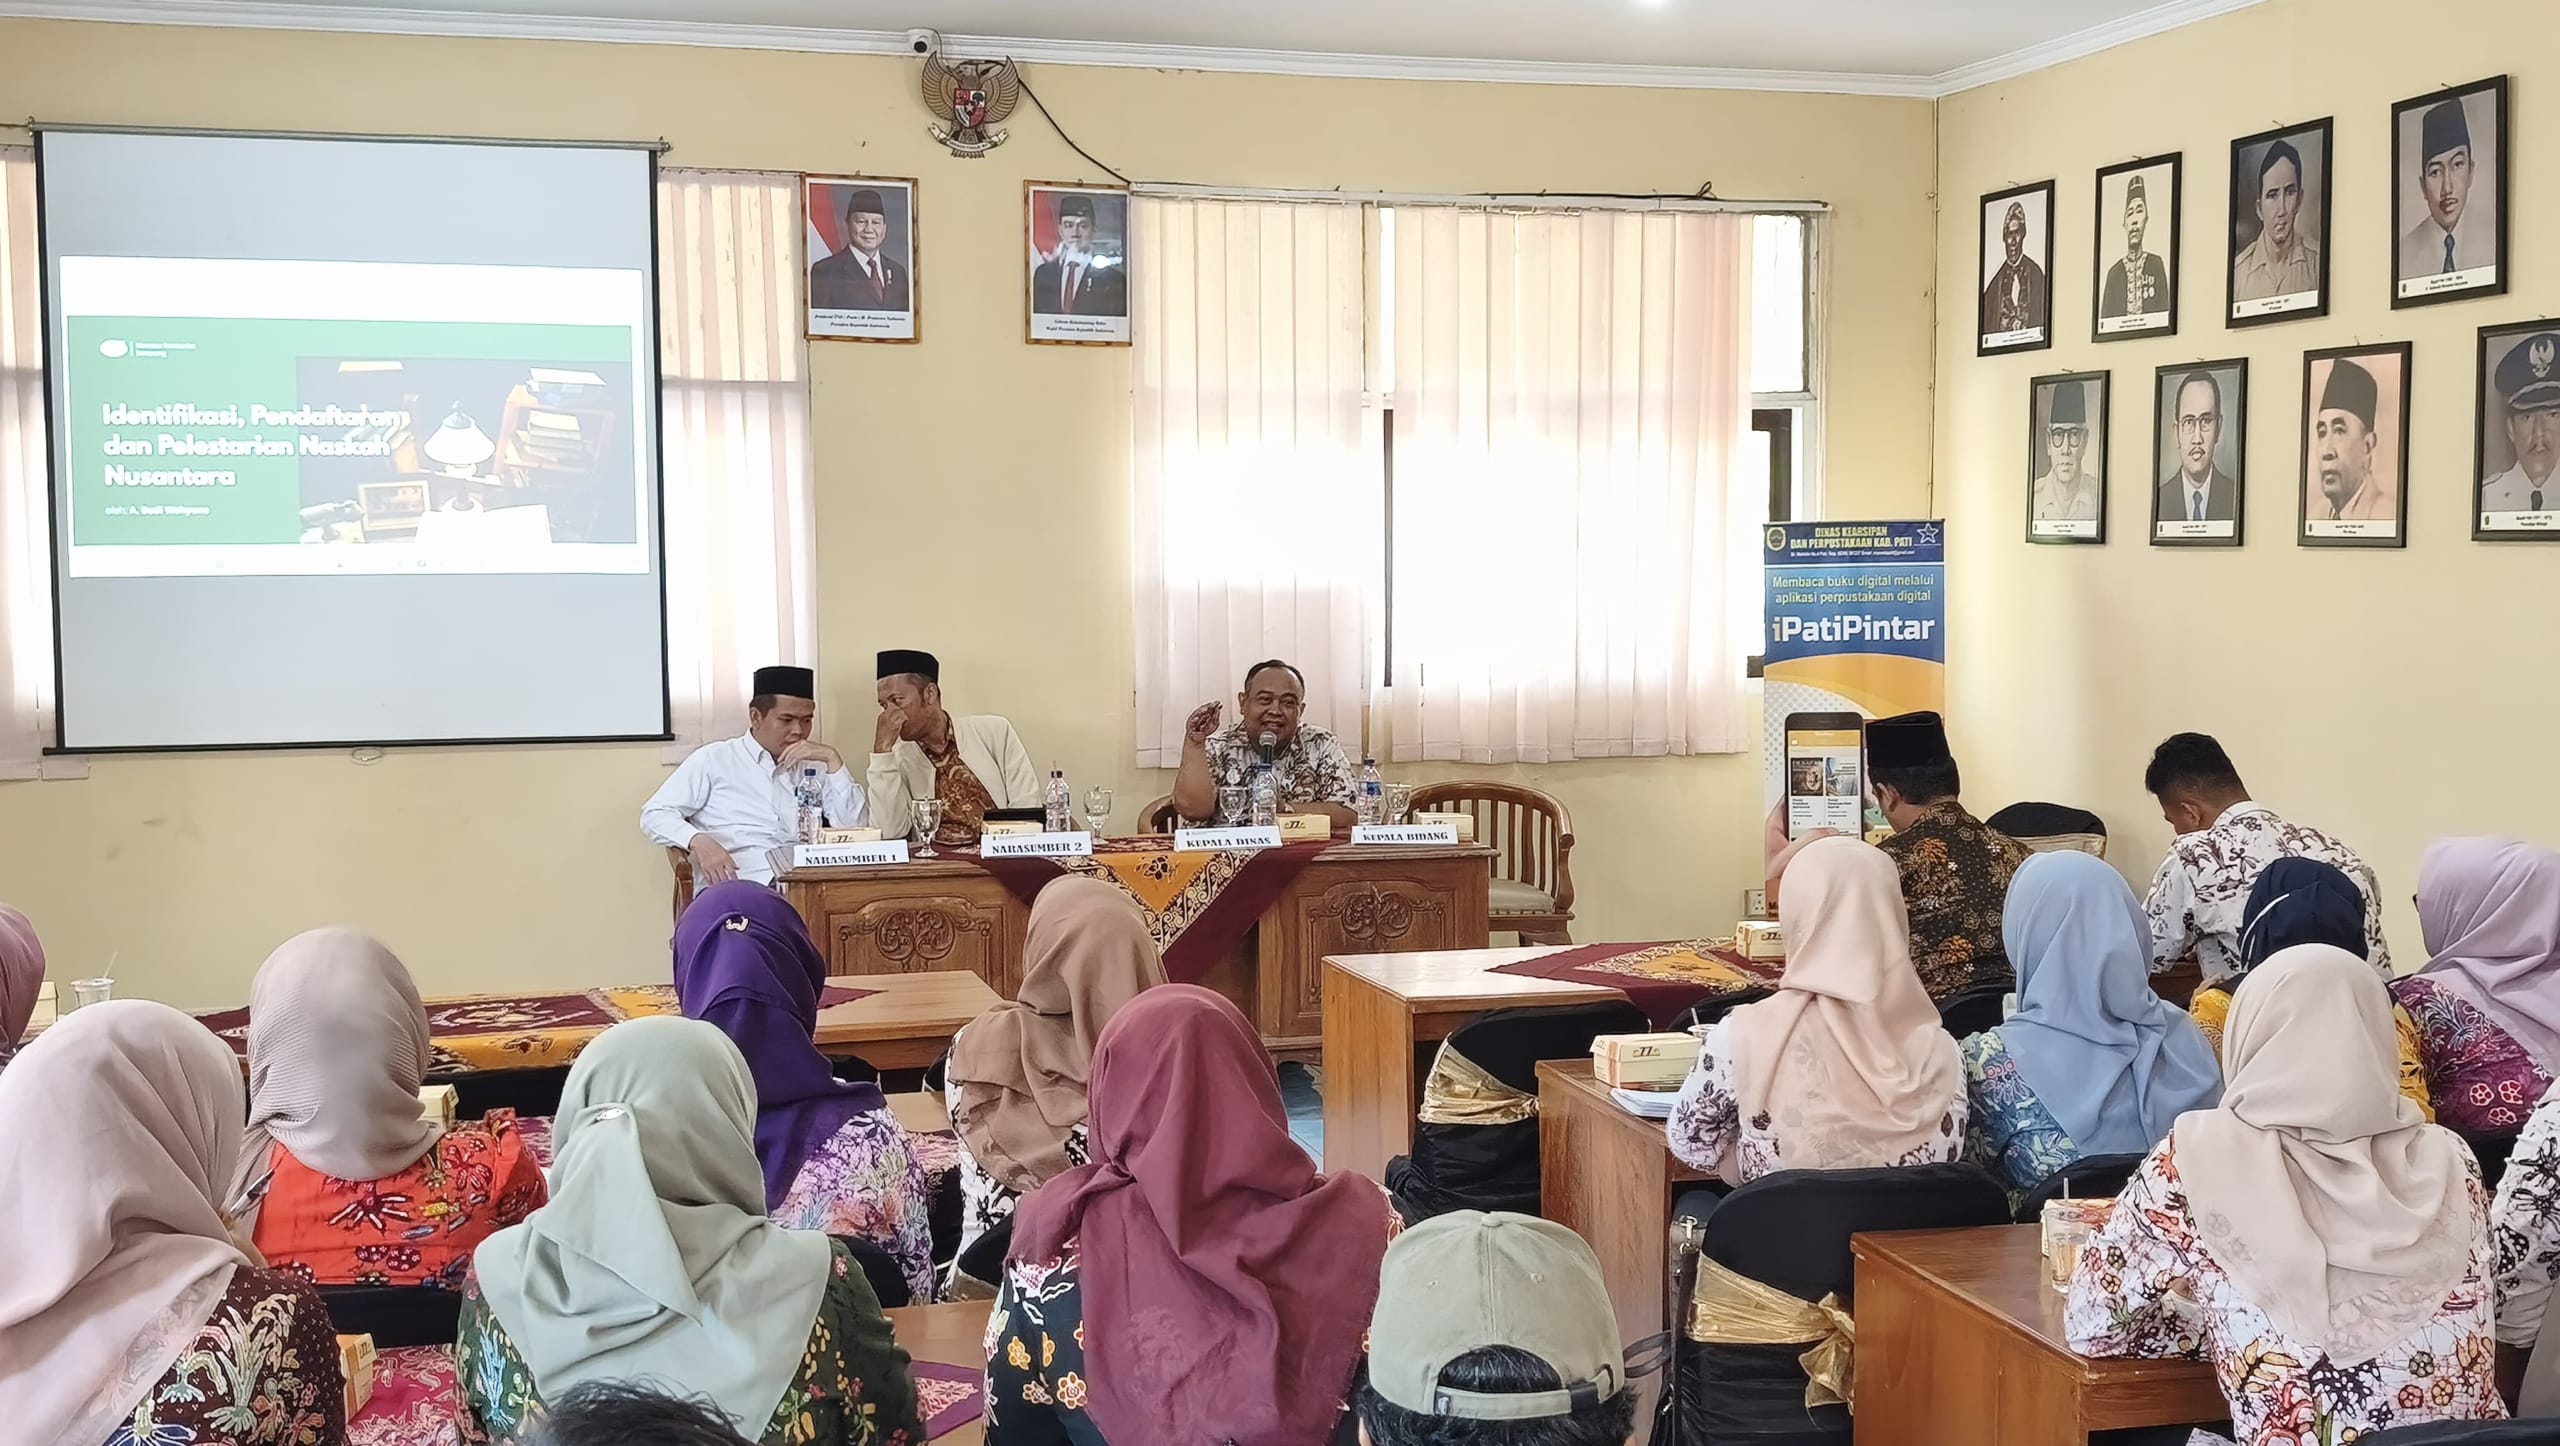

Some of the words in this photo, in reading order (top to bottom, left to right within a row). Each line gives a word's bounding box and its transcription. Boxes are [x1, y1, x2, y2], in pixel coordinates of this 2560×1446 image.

[102, 402, 246, 429] Identifikasi,
[250, 403, 401, 427] Pendaftaran
[103, 433, 153, 456] dan
[157, 433, 295, 457] Pelestarian
[299, 434, 391, 456] Naskah
[104, 463, 237, 487] Nusantara
[1815, 527, 1840, 537] DINAS
[1790, 539, 1808, 549] DAN
[1808, 537, 1873, 549] PERPUSTAKAAN
[1873, 537, 1893, 548] KAB.
[1894, 537, 1913, 547] PATI
[1773, 576, 1825, 588] Membaca
[1827, 575, 1855, 587] buku
[1857, 574, 1891, 588] digital
[1894, 573, 1934, 586] melalui
[1775, 592, 1818, 605] aplikasi
[1820, 591, 1894, 605] perpustakaan
[1897, 590, 1931, 604] digital
[1772, 615, 1936, 643] iPatiPintar
[1186, 838, 1232, 848] KEPALA
[1235, 837, 1272, 846] DINAS
[1363, 833, 1403, 841] KEPALA
[1407, 831, 1448, 841] BIDANG
[992, 843, 1071, 854] NARASUMBER
[1074, 842, 1083, 852] 2
[805, 854, 887, 865] NARASUMBER
